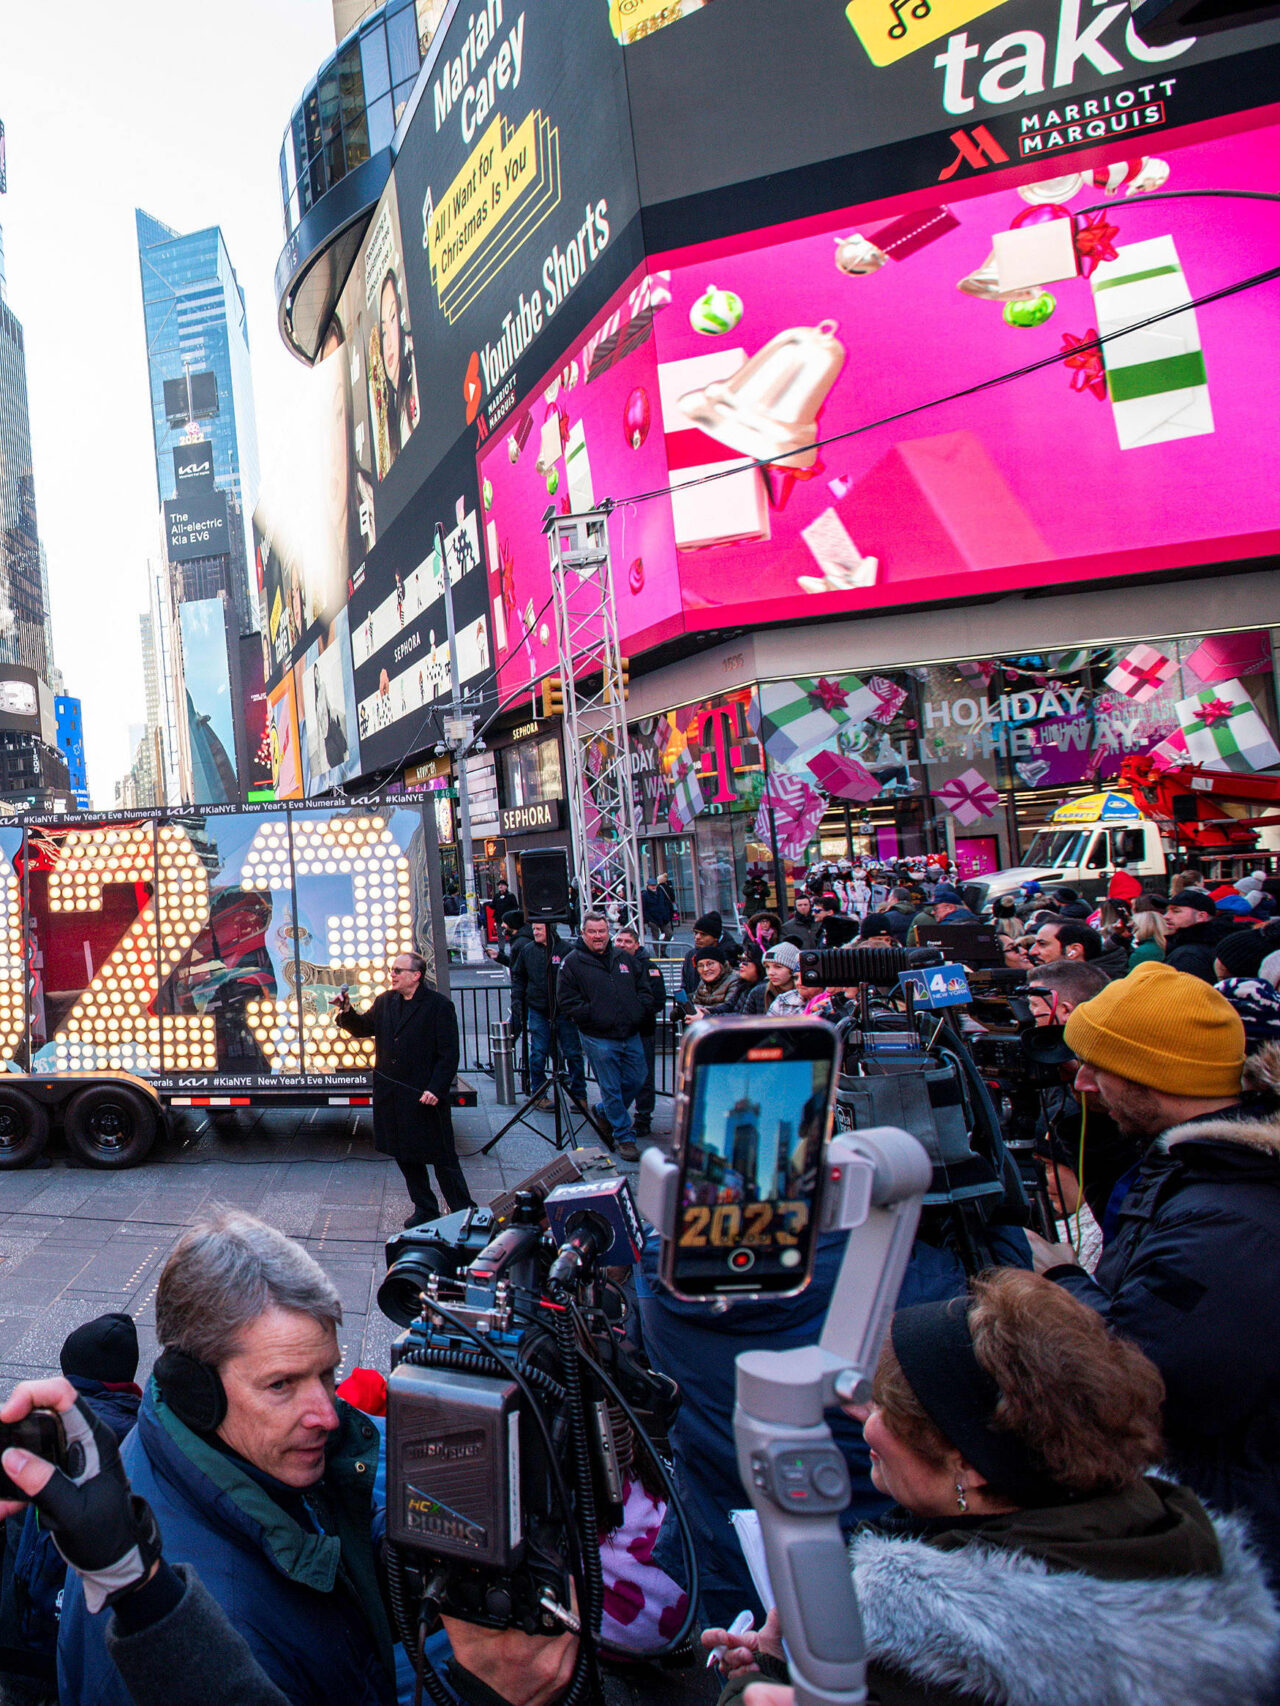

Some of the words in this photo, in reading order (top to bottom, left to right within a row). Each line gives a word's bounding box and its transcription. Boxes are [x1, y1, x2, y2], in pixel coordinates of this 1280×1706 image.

[934, 0, 1198, 114] tak
[460, 12, 525, 144] Carey
[1020, 80, 1177, 131] MARRIOTT
[1022, 104, 1163, 155] MARQUIS
[435, 210, 445, 248] All
[453, 168, 476, 220] Want
[479, 146, 494, 184] for
[441, 200, 487, 274] Christmas
[491, 182, 501, 210] Is
[505, 145, 526, 191] You
[480, 289, 543, 395] YouTube
[542, 198, 610, 318] Shorts
[488, 374, 517, 415] MARRIOTT
[489, 391, 515, 429] MARQUIS
[170, 513, 188, 523] The
[171, 518, 223, 534] All-electric
[172, 535, 188, 546] Kia
[190, 530, 210, 543] EV6
[395, 632, 420, 662] SEPHORA
[924, 687, 1085, 728] HOLIDAY
[513, 722, 538, 739] SEPHORA
[24, 814, 59, 824] #KiaNYE
[63, 813, 82, 822] New
[83, 812, 105, 822] Year's
[106, 811, 122, 820] Eve
[123, 808, 161, 819] Numerals
[200, 804, 237, 815] #KiaNYE
[242, 803, 259, 812] New
[261, 801, 284, 812] Year's
[286, 800, 303, 810] Eve
[305, 798, 346, 810] Numerals
[386, 793, 424, 803] #KiaNYE
[504, 805, 551, 829] SEPHORA
[930, 974, 947, 992] 4
[213, 1076, 252, 1087] #KiaNYE
[258, 1077, 275, 1085] New
[278, 1076, 305, 1086] Year's
[307, 1075, 323, 1085] Eve
[325, 1074, 367, 1085] Numerals
[678, 1201, 809, 1247] 2023
